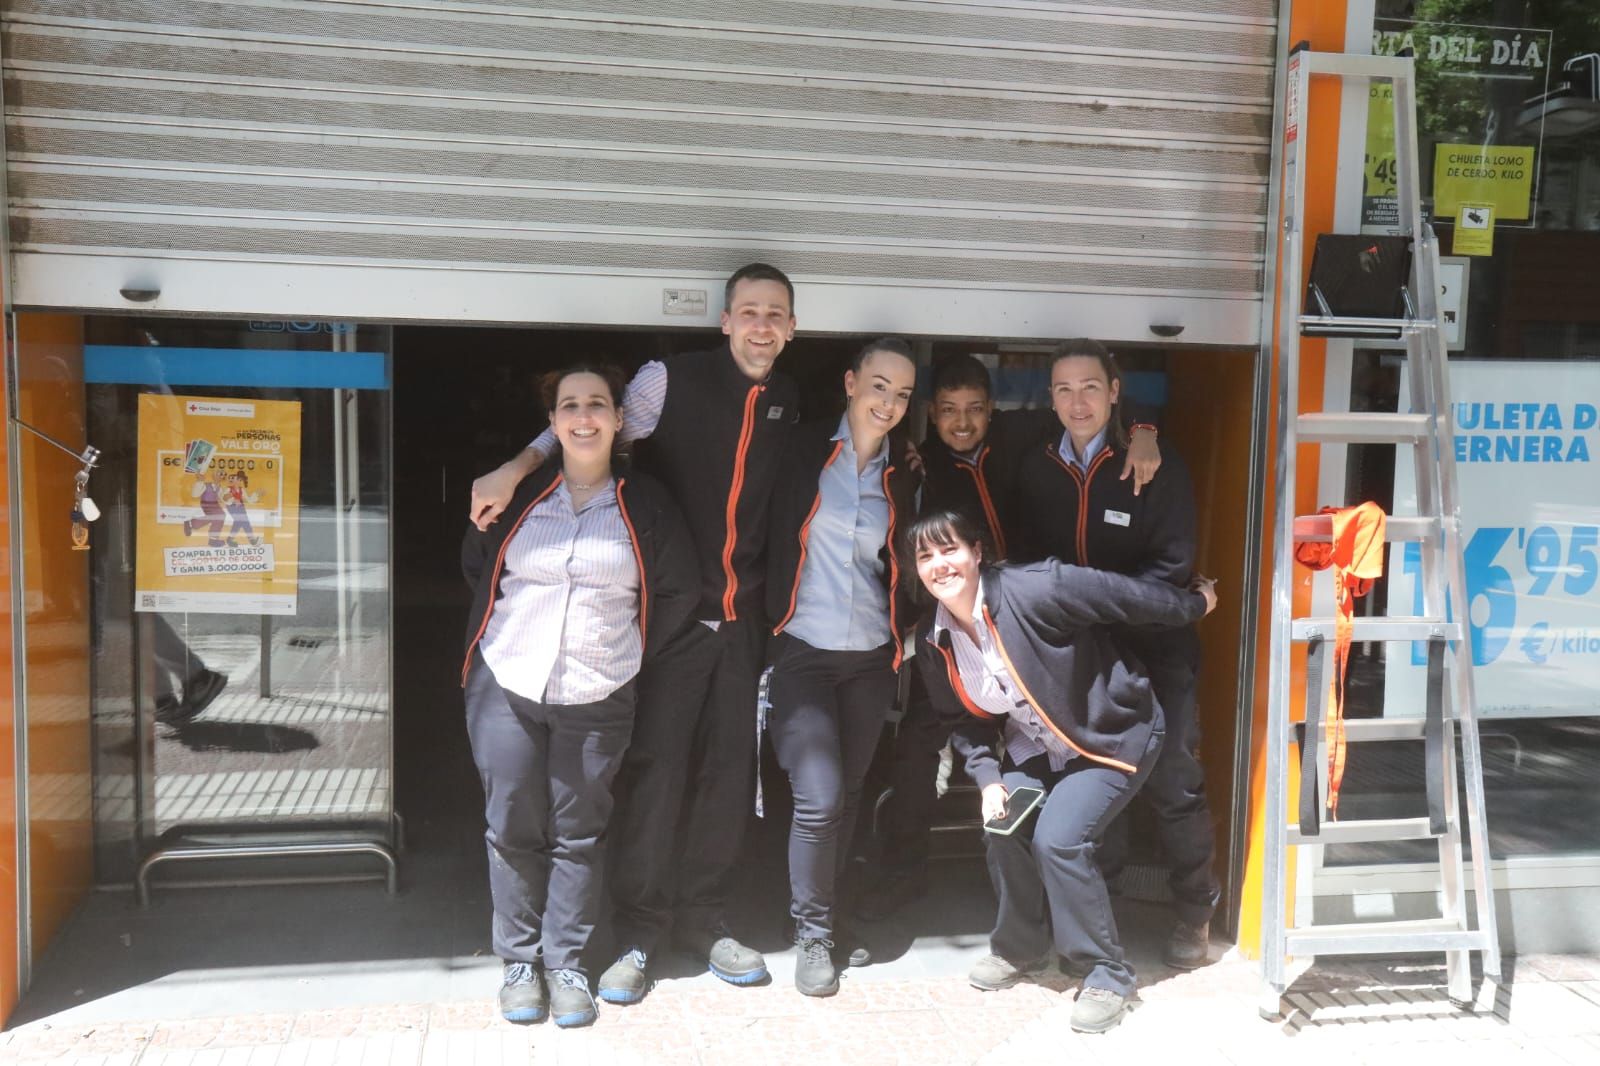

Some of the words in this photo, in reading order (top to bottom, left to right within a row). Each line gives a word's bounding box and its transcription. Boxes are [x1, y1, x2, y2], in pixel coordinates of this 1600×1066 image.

[1427, 35, 1481, 63] DEL
[1490, 33, 1544, 67] DÍA
[1448, 154, 1490, 164] CHULETA
[1493, 156, 1524, 166] LOMO
[1447, 167, 1460, 177] DE
[1501, 169, 1524, 179] KILO
[1452, 403, 1563, 430] ULETA
[236, 432, 281, 441] PERSONAS
[221, 440, 249, 449] VALE
[252, 440, 281, 451] ORO
[1453, 435, 1590, 462] ERNERA
[163, 457, 181, 467] 6€
[171, 549, 211, 558] COMPRA
[229, 547, 265, 556] BOLETO
[180, 565, 205, 573] GANA
